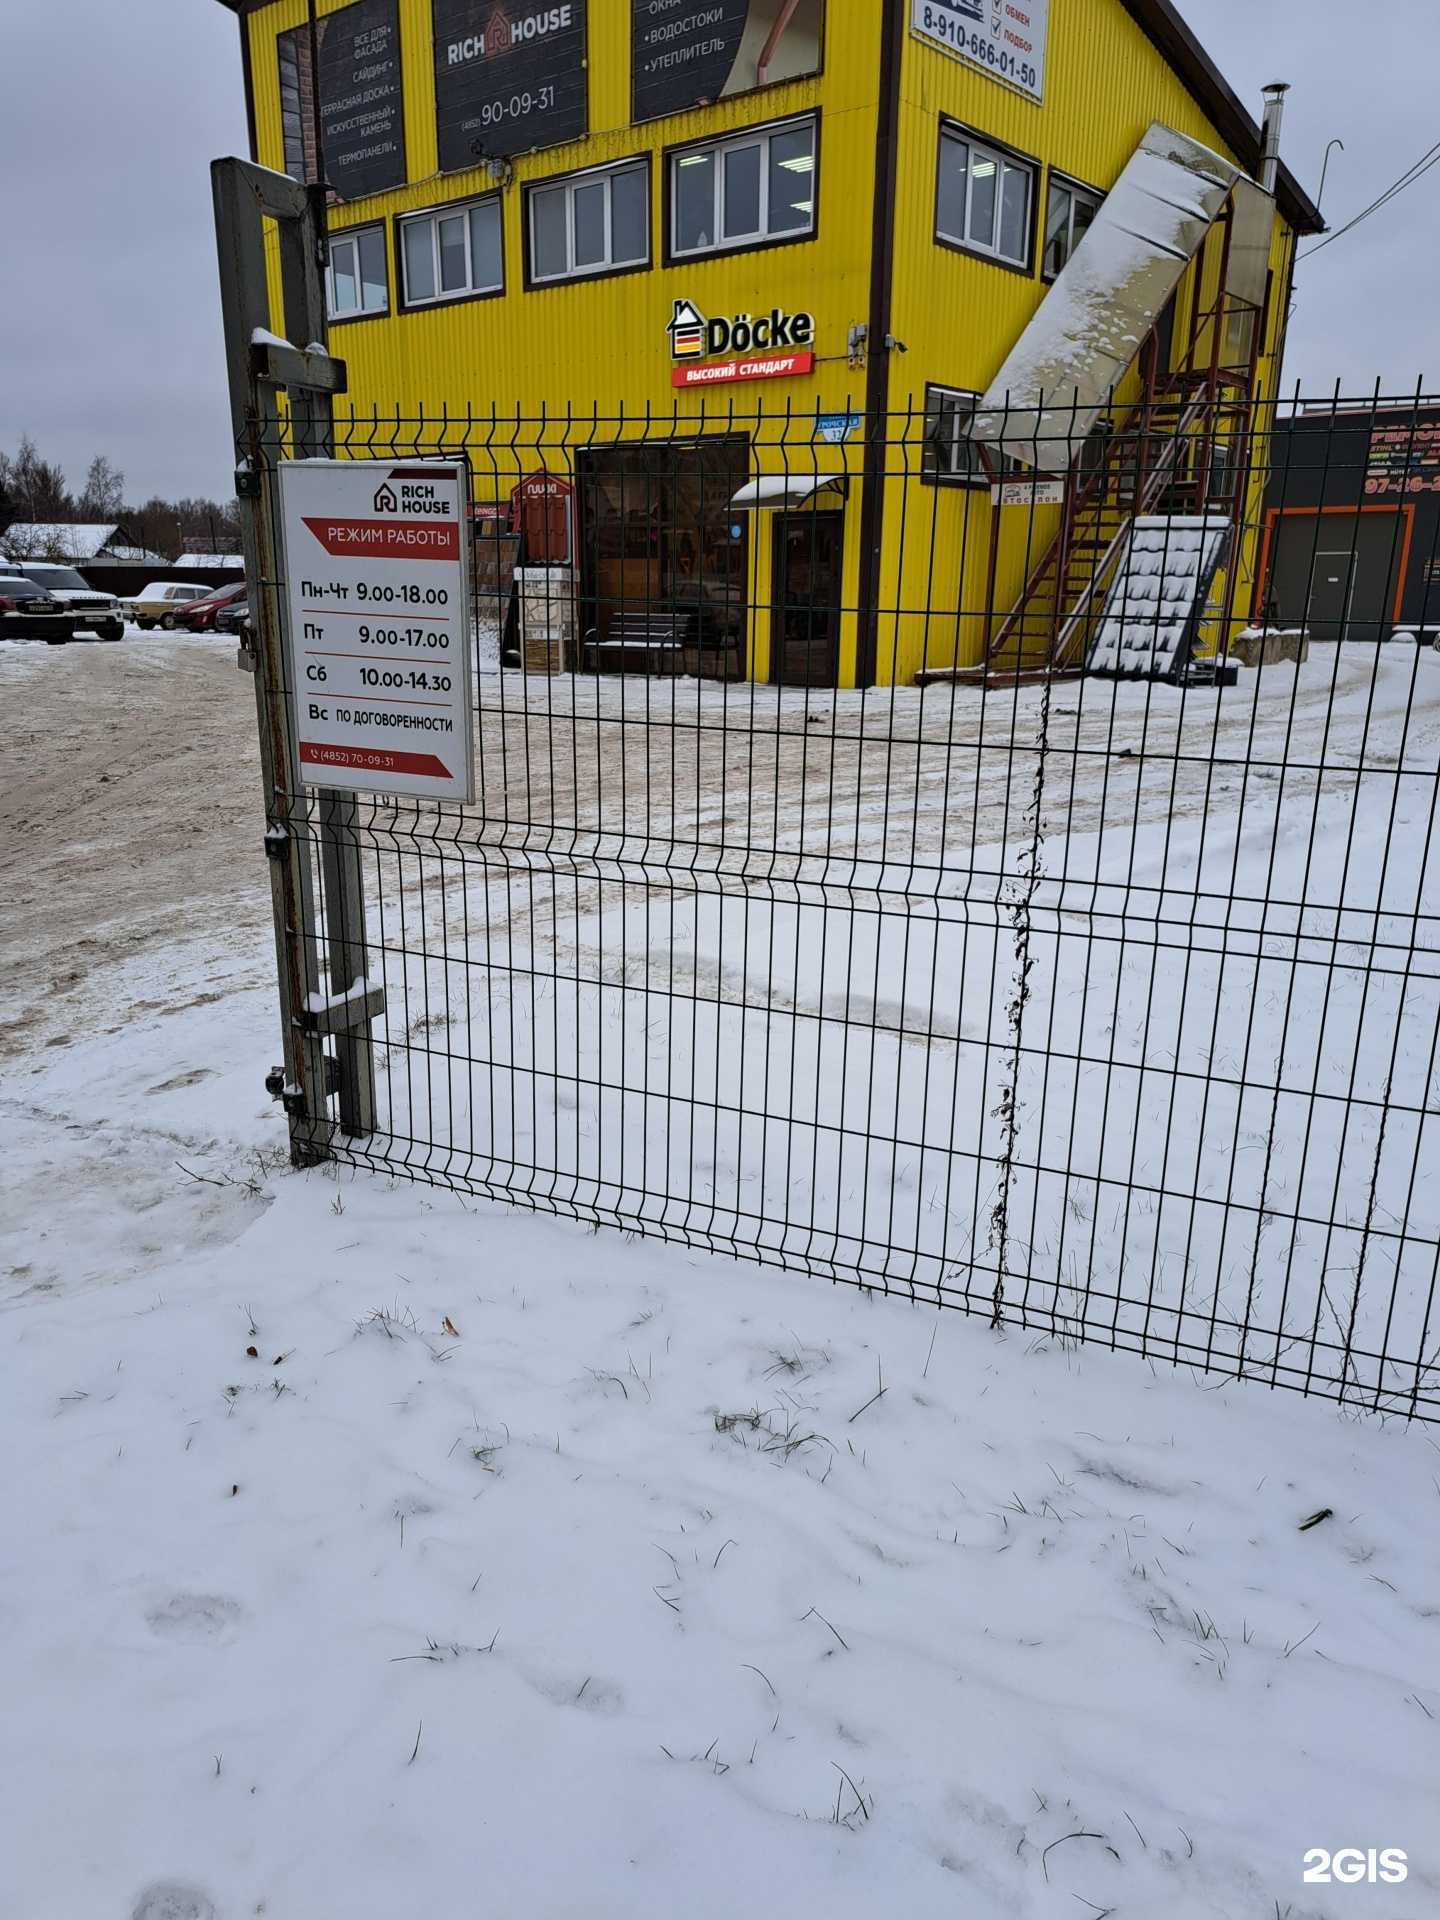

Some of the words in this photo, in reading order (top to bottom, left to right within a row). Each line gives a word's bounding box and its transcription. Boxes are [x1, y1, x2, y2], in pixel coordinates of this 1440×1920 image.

[650, 7, 723, 43] ВОДОСТОКИ
[1005, 5, 1030, 28] ОБМЕН
[354, 32, 369, 47] ВСЕ
[448, 34, 485, 64] RICH
[511, 5, 572, 43] HOUSE
[1004, 29, 1032, 53] ПОДБОР
[354, 39, 388, 59] ФАСАДА
[650, 38, 725, 72] УТЕПЛИТЕЛЬ
[924, 6, 1036, 88] 8-910-666-01-50
[353, 60, 388, 83] САЙДИНГ
[363, 85, 391, 104] ДОСКА
[481, 86, 554, 125] 90-09-31
[327, 105, 391, 135] ИСКУССТВЕННЫЙ
[361, 120, 392, 136] КАМЕНЬ
[338, 142, 393, 165] ТЕРМОПАНЕЛИ
[707, 309, 812, 354] Döcke
[686, 363, 736, 381] ВЫСОКИЙ
[739, 359, 795, 376] СТАНДАРТ
[401, 485, 435, 499] RICH
[401, 500, 450, 514] HOUSE
[328, 528, 383, 543] РЕЖИМ
[387, 530, 450, 546] РАБОТЫ
[301, 581, 349, 600] Пн-Чт
[357, 583, 449, 605] 9.00-18.00
[304, 624, 324, 641] Пт
[359, 626, 449, 649] 9.00-17.00
[307, 665, 327, 682] Сб
[360, 668, 451, 691] 10.00-14.30
[309, 704, 329, 721] Вс
[336, 709, 351, 723] ПО
[353, 710, 453, 732] ДОГОВОРЕННОСТИ
[320, 749, 349, 764] (4852)
[351, 752, 394, 767] 70-09-31
